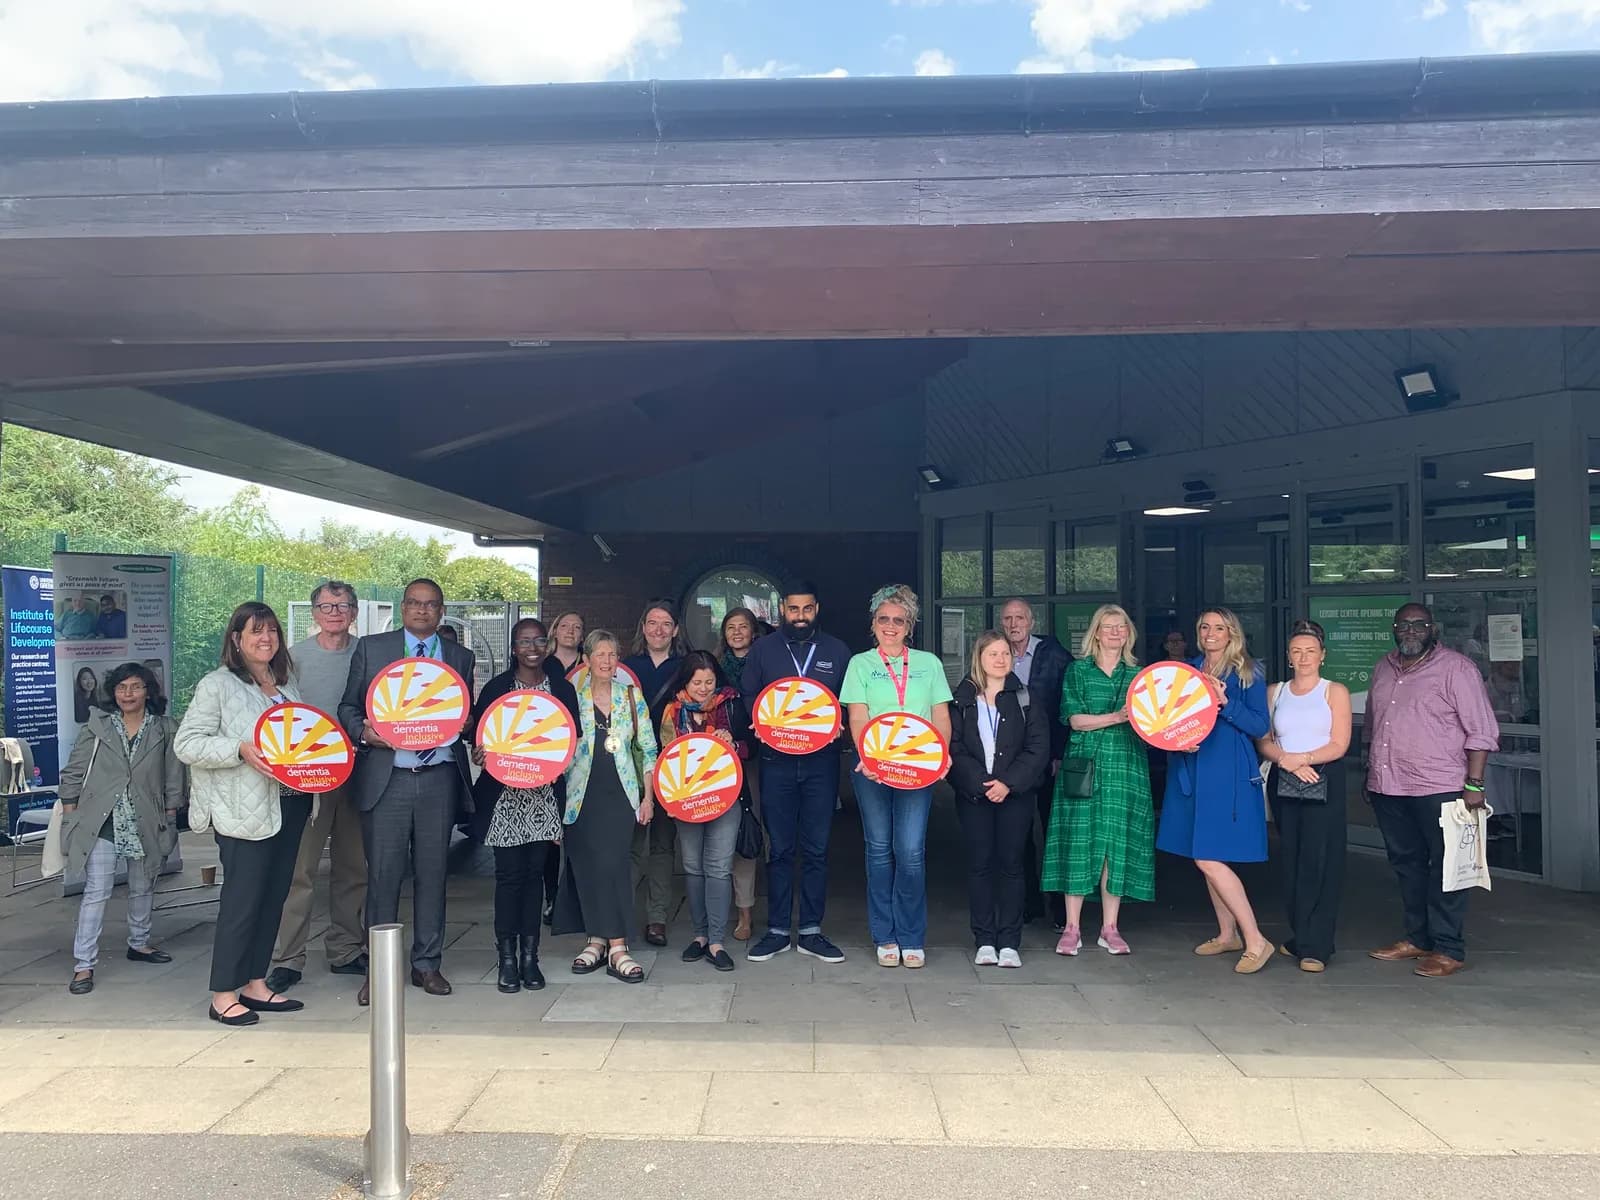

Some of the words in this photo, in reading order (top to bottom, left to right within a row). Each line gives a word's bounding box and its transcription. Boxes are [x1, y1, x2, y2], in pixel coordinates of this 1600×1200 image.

[10, 608, 44, 620] Institute
[44, 610, 54, 620] fo
[10, 622, 52, 634] Lifecourse
[11, 636, 55, 649] Developme
[393, 724, 438, 734] dementia
[771, 729, 810, 741] dementia
[1164, 719, 1200, 740] dementia
[496, 758, 540, 772] dementia
[878, 762, 918, 777] dementia
[287, 767, 330, 776] dementia
[681, 794, 720, 811] dementia
